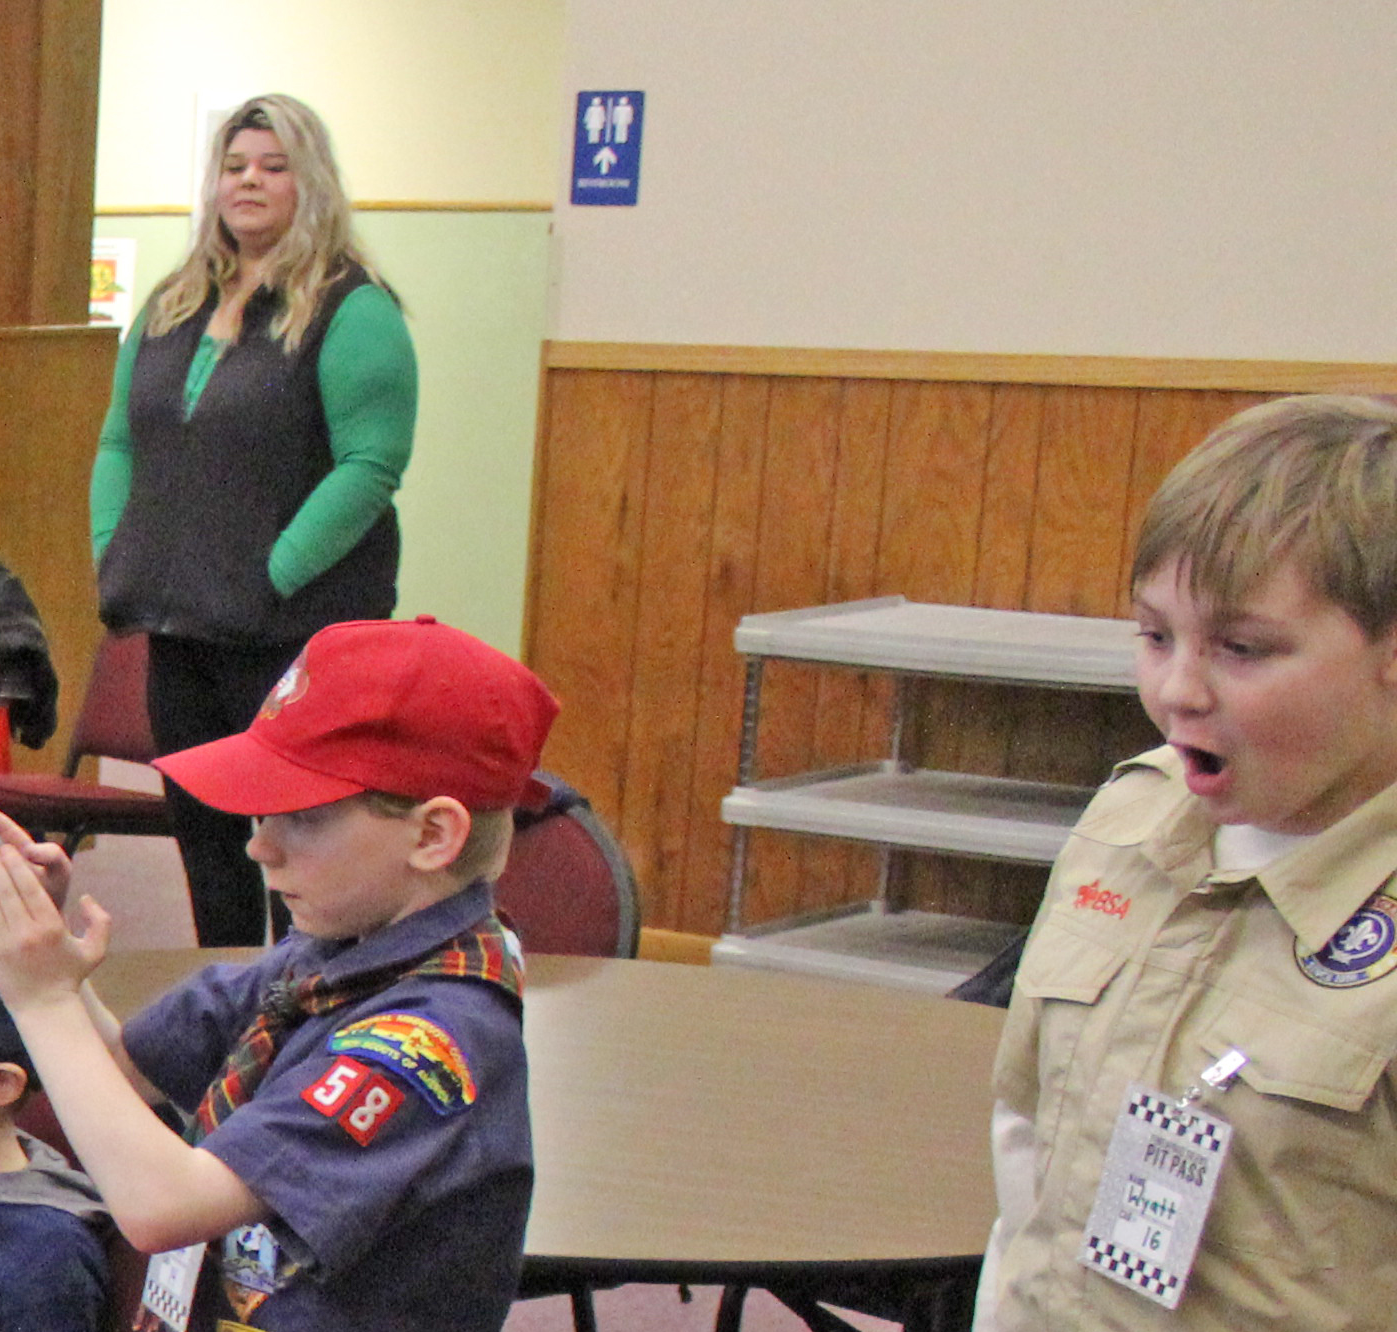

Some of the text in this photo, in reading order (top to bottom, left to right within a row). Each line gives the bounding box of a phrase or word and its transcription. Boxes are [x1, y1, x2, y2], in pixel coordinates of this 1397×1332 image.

[1092, 889, 1132, 920] BSA
[313, 1065, 391, 1131] 58
[1144, 1143, 1169, 1170] PIT
[1169, 1154, 1207, 1187] PASS
[1128, 1184, 1176, 1220] Wyatt
[1142, 1226, 1162, 1251] 16
